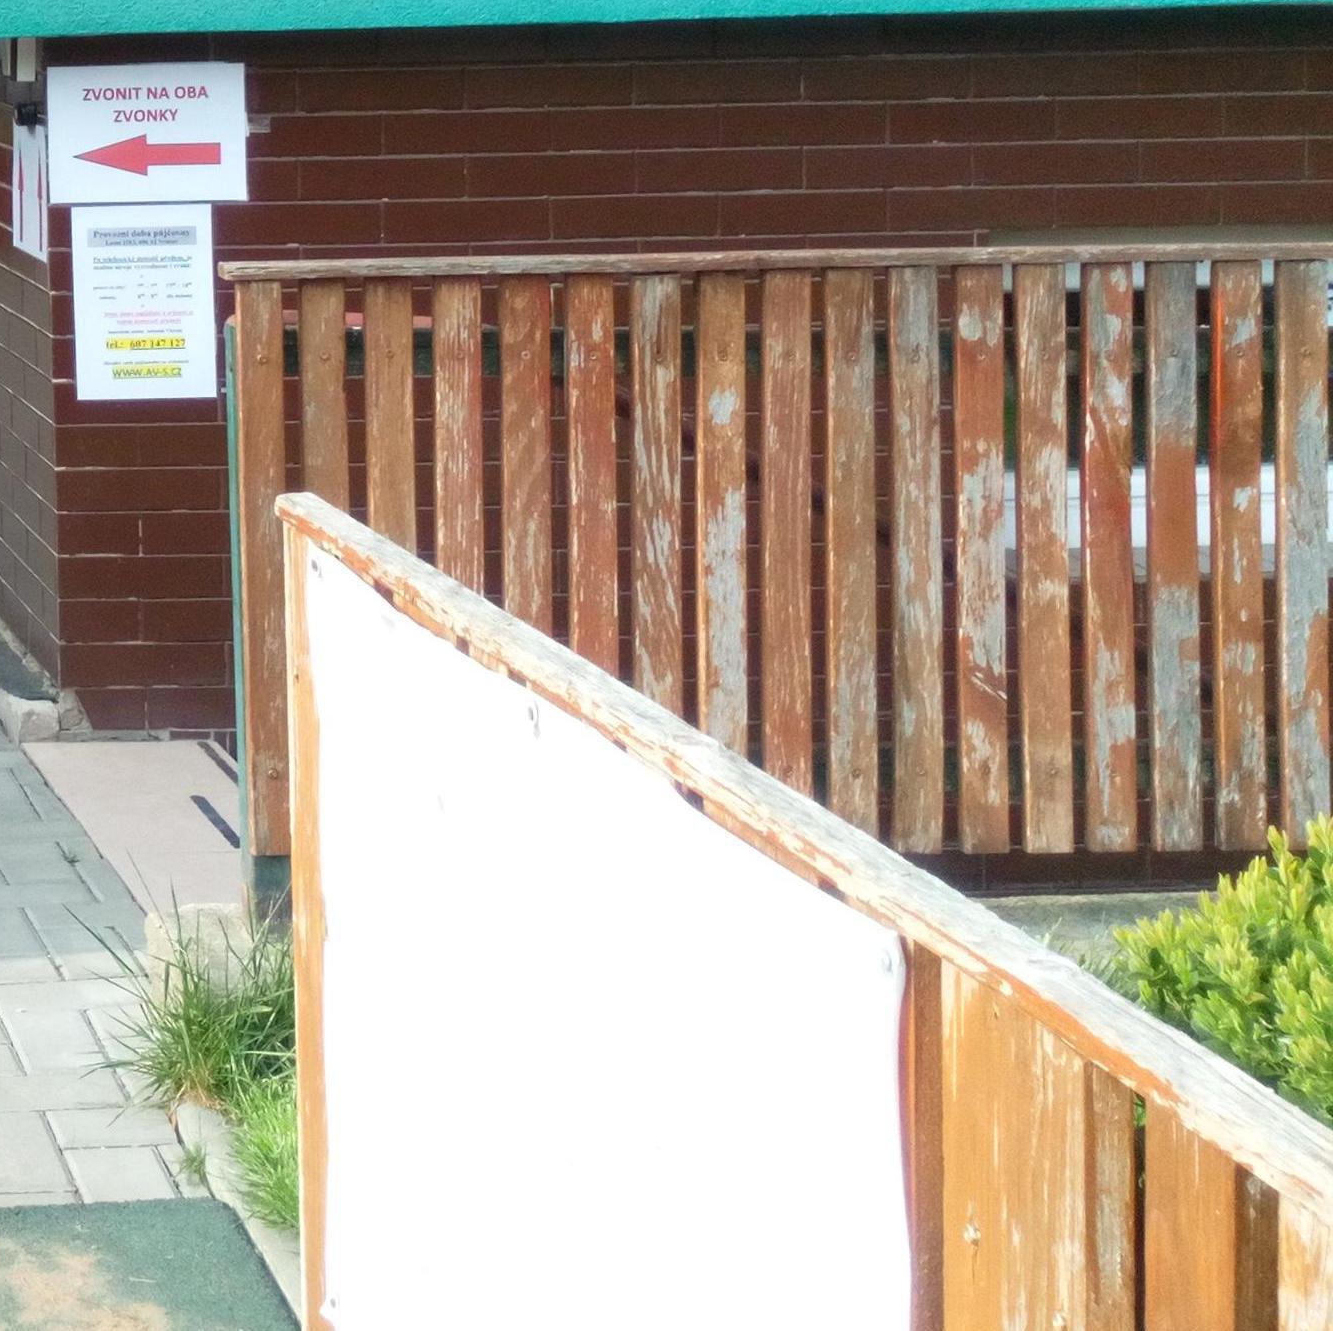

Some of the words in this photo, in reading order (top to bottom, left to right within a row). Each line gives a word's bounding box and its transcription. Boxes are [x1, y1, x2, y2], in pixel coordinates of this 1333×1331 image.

[82, 86, 141, 102] ZVONIT
[146, 86, 170, 101] NA
[174, 85, 209, 100] OBA
[113, 108, 179, 123] ZVONKY
